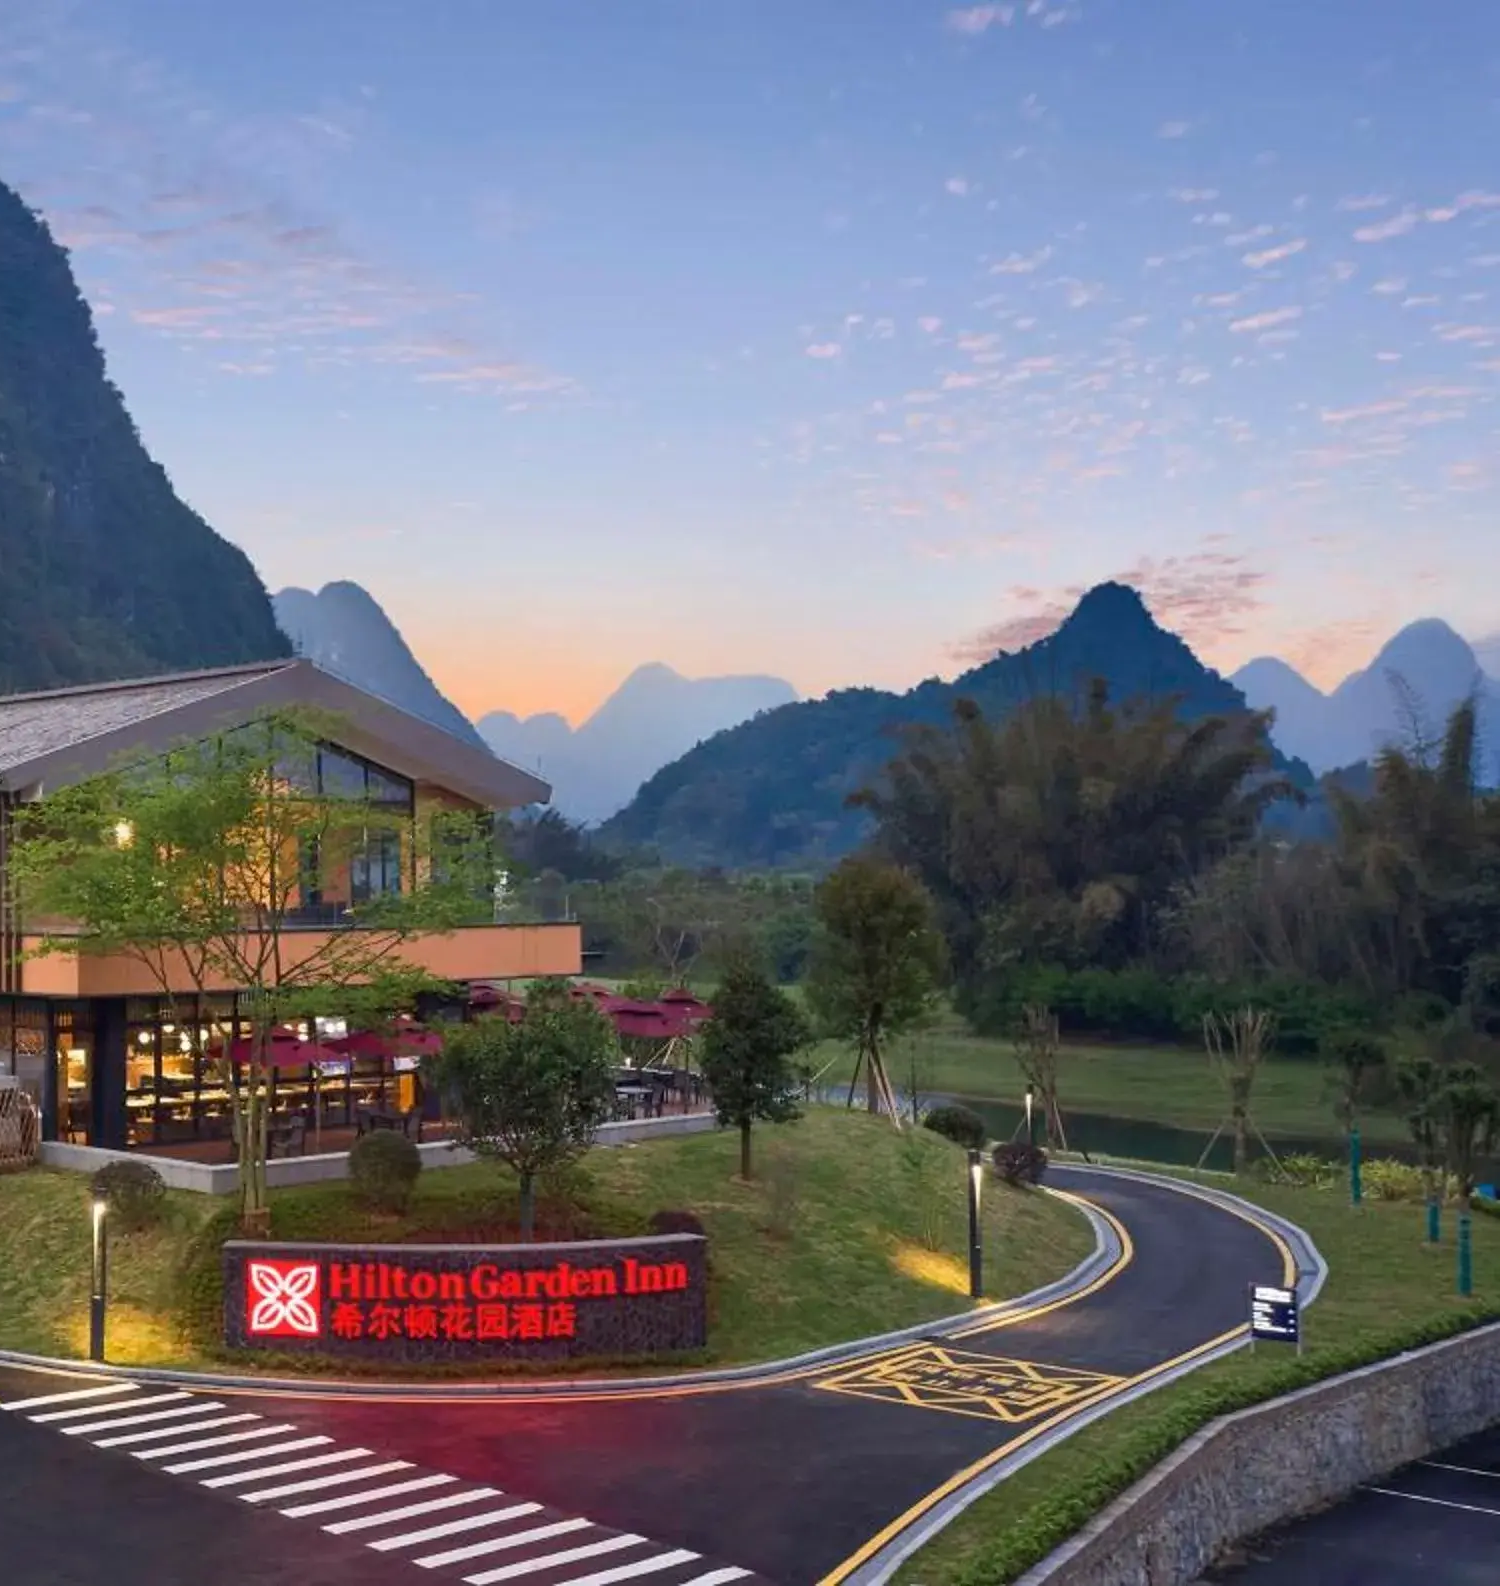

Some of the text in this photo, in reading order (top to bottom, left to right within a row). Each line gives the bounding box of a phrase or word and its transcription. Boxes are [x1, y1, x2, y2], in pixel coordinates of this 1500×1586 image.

[329, 1259, 687, 1302] Hilton Garden Inn
[331, 1302, 577, 1340] 希尔顿花园酒店
